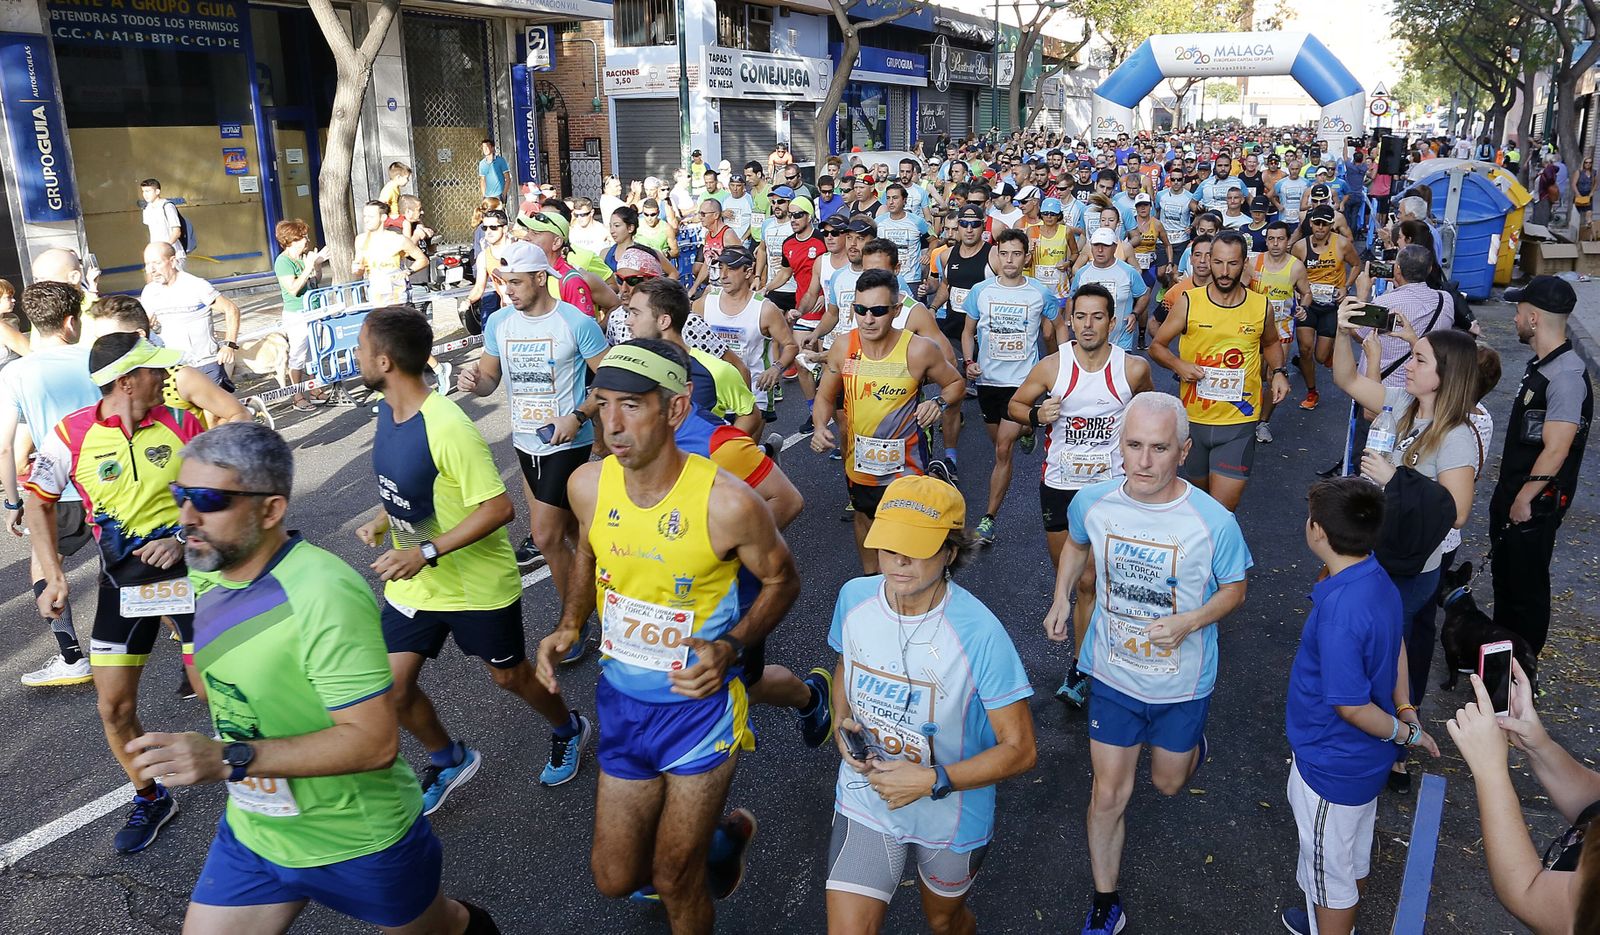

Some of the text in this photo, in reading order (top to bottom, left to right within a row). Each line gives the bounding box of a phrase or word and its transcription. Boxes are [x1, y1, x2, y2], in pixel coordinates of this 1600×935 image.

[132, 0, 190, 14] GRUPO
[197, 3, 236, 18] GUIA
[567, 3, 580, 11] VIAL
[51, 10, 239, 33] BTENDRAS TODOS LOS PERMISOS
[94, 31, 104, 40] A
[112, 31, 128, 41] A1
[135, 32, 144, 42] B
[151, 33, 174, 44] BTP
[181, 35, 190, 45] C
[197, 36, 211, 46] C1
[219, 37, 226, 47] D
[234, 38, 240, 48] E
[708, 53, 733, 64] TAPAS Y
[1174, 46, 1211, 65] 2020
[886, 57, 914, 70] GRUPOGUIA
[24, 45, 39, 98] AUTOESCUELAS
[605, 69, 640, 78] RACIONES
[709, 67, 733, 77] JUEGOS
[740, 63, 810, 87] COMEJUEGA
[615, 77, 631, 86] 3,50
[709, 79, 734, 89] DE MESA
[1373, 103, 1385, 111] 30
[1096, 116, 1125, 132] 2020
[1322, 116, 1352, 132] 2020
[526, 110, 537, 179] GRUPOGUIA
[32, 105, 62, 211] GRUPOGUIA
[1076, 190, 1090, 200] 261
[511, 343, 546, 353] VIVELA
[998, 341, 1024, 351] 758
[1209, 377, 1241, 390] 787
[262, 386, 298, 401] POLICIA LOCAL
[1065, 430, 1113, 440] RUEDAS
[864, 448, 901, 463] 468
[1114, 543, 1168, 564] VIVELA
[1116, 562, 1161, 578] EL TORCAL
[1125, 571, 1153, 584] LA PAZ
[140, 581, 188, 600] 656
[623, 605, 651, 618] TORCAL
[623, 617, 682, 649] 760
[857, 673, 922, 706] VIVELA
[871, 704, 915, 726] TORCAL
